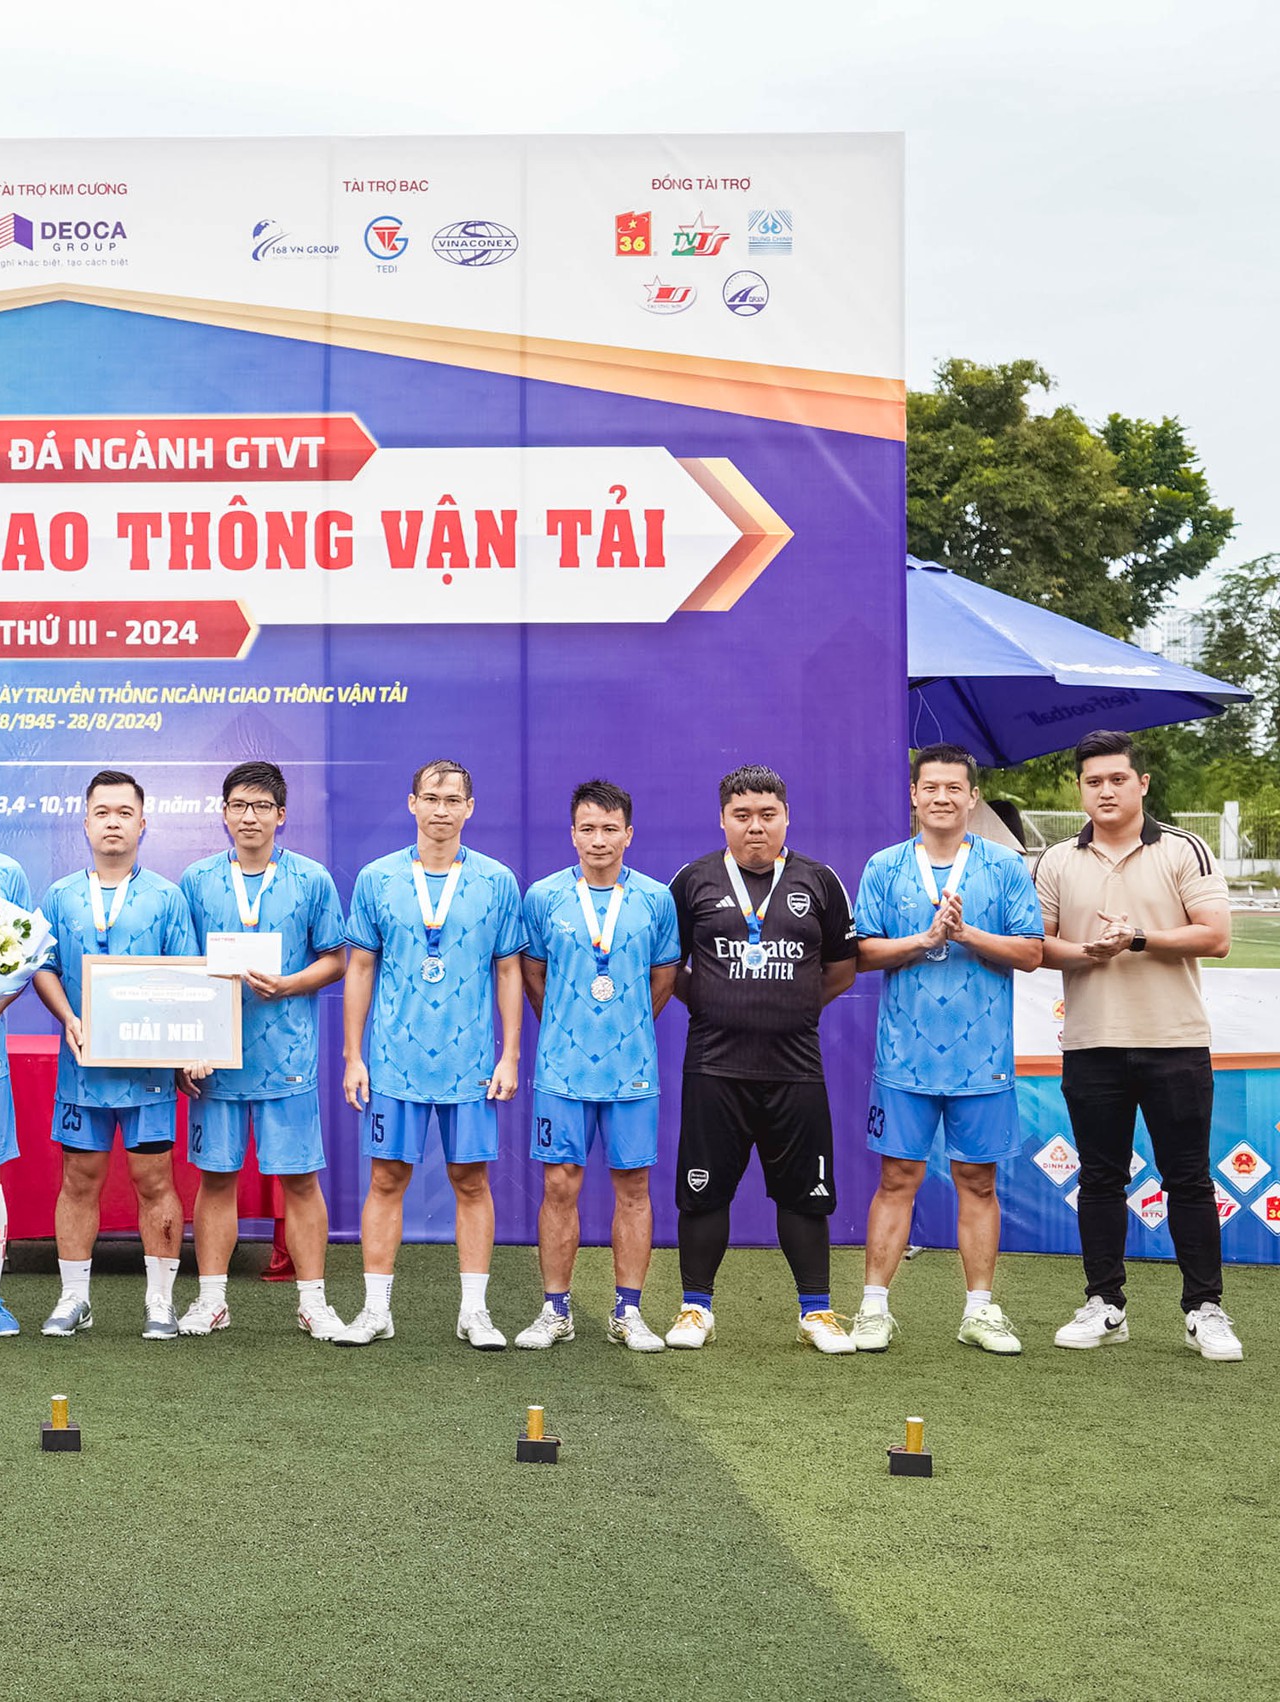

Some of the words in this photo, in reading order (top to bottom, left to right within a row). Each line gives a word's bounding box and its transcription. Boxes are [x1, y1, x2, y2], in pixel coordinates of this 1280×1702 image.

[18, 182, 47, 198] TRỢ
[50, 183, 73, 195] KIM
[77, 182, 128, 196] CƯƠNG
[343, 178, 364, 193] TÀI
[367, 179, 397, 194] TRỢ
[400, 180, 429, 195] BẠC
[696, 175, 718, 190] TÀI
[721, 176, 751, 192] TRỢ
[40, 221, 128, 240] DEOCA
[52, 242, 117, 251] GROUP
[272, 246, 288, 254] 168
[306, 245, 339, 254] GROUP
[438, 239, 513, 248] VINACONEX
[619, 236, 646, 252] 36
[18, 258, 39, 267] khác
[85, 258, 107, 267] cách
[110, 258, 129, 267] biệt
[376, 265, 398, 273] TEDI
[8, 430, 63, 470] ĐÁ
[74, 429, 214, 470] NGÀNH
[225, 436, 326, 469] GTVT
[116, 494, 354, 571] THÔNG
[381, 493, 518, 586] VẬN
[547, 484, 666, 570] TẢI
[68, 619, 97, 645] III
[106, 629, 118, 638] -
[125, 619, 199, 645] 2024
[26, 681, 96, 704] TRUYỀN
[98, 681, 160, 704] THỐNG
[160, 684, 226, 704] NGÀNH
[228, 687, 270, 703] GIAO
[273, 683, 335, 703] THÔNG
[337, 683, 376, 707] VẬN
[378, 681, 408, 703] TẢI
[68, 711, 163, 731] 28/8/2024)
[39, 796, 83, 815] 10,11
[158, 795, 201, 813] năm
[204, 796, 225, 813] 20
[714, 937, 805, 960] Emrates
[119, 1016, 161, 1041] GIẢI
[62, 1103, 82, 1132] 25
[371, 1112, 385, 1143] 15
[536, 1116, 552, 1147] 13
[818, 1155, 825, 1180] 1
